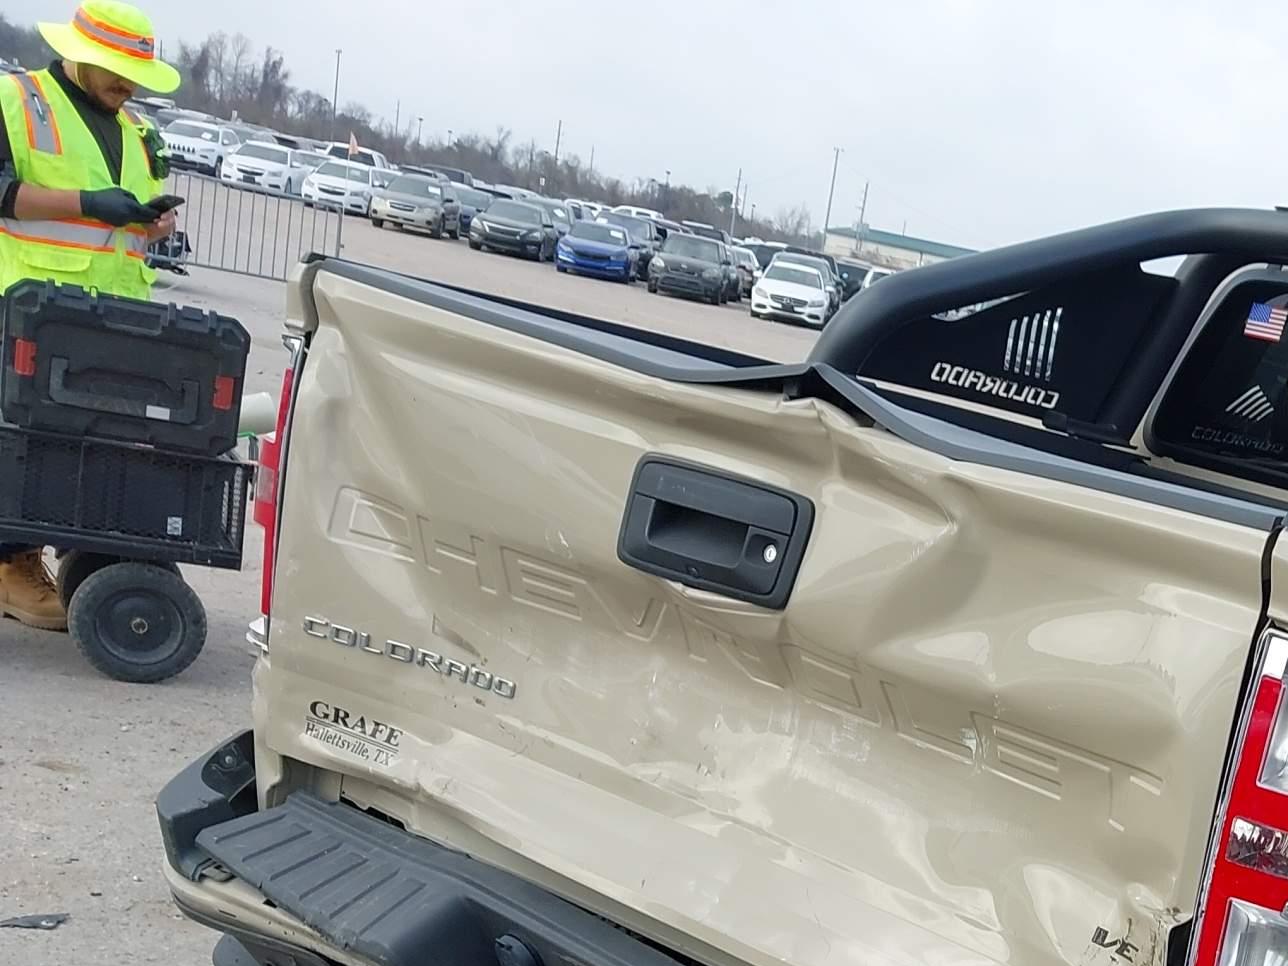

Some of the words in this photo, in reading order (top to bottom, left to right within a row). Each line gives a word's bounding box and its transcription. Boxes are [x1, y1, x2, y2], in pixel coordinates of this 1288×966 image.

[303, 615, 517, 699] COLORADO
[327, 485, 1164, 832] CHEVROLET
[305, 722, 370, 760] Hallettsville,
[373, 748, 395, 766] TX
[309, 700, 404, 747] GRAFE
